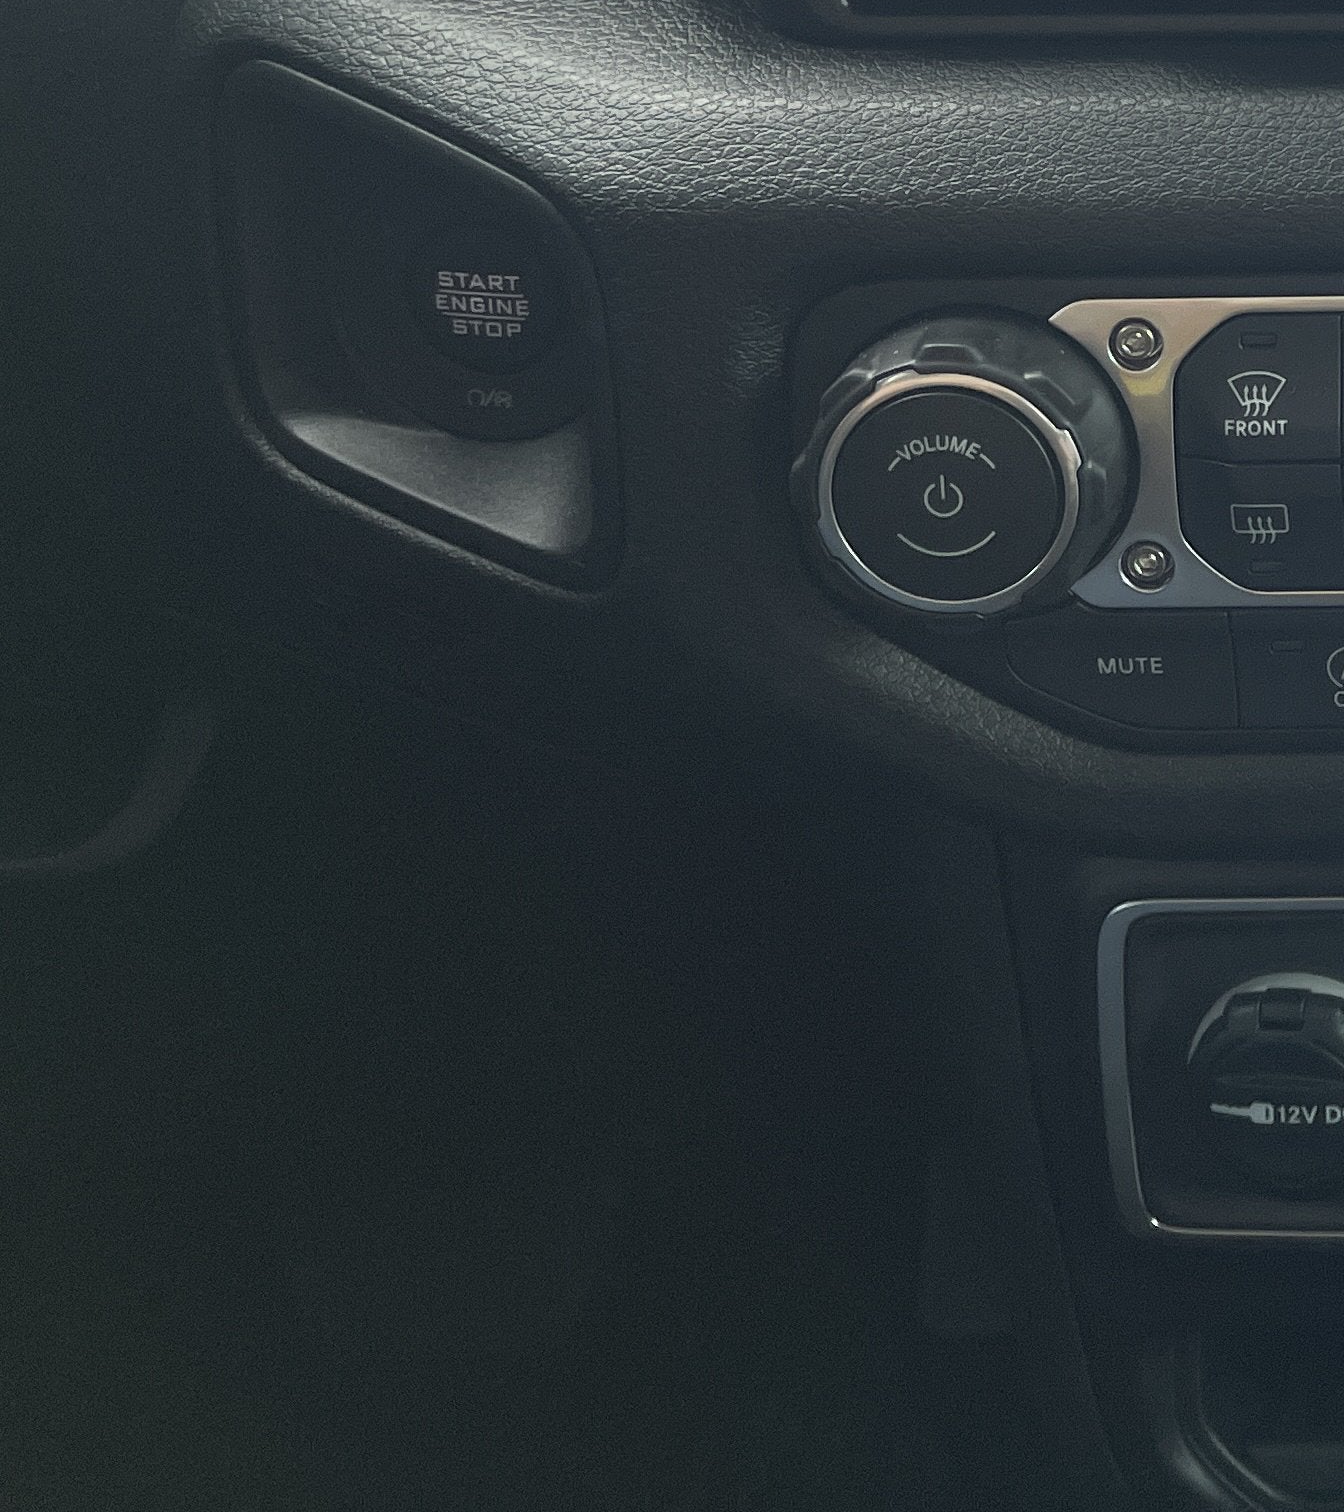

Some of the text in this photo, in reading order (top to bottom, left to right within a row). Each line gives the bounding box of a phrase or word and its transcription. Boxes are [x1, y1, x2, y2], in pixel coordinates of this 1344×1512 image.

[438, 271, 519, 291] START
[435, 294, 529, 316] ENGINE
[453, 319, 521, 337] STOP
[1224, 419, 1288, 436] FRONT
[896, 436, 982, 462] VOLUME
[1097, 657, 1163, 675] MUTE
[1276, 1105, 1317, 1125] 12V
